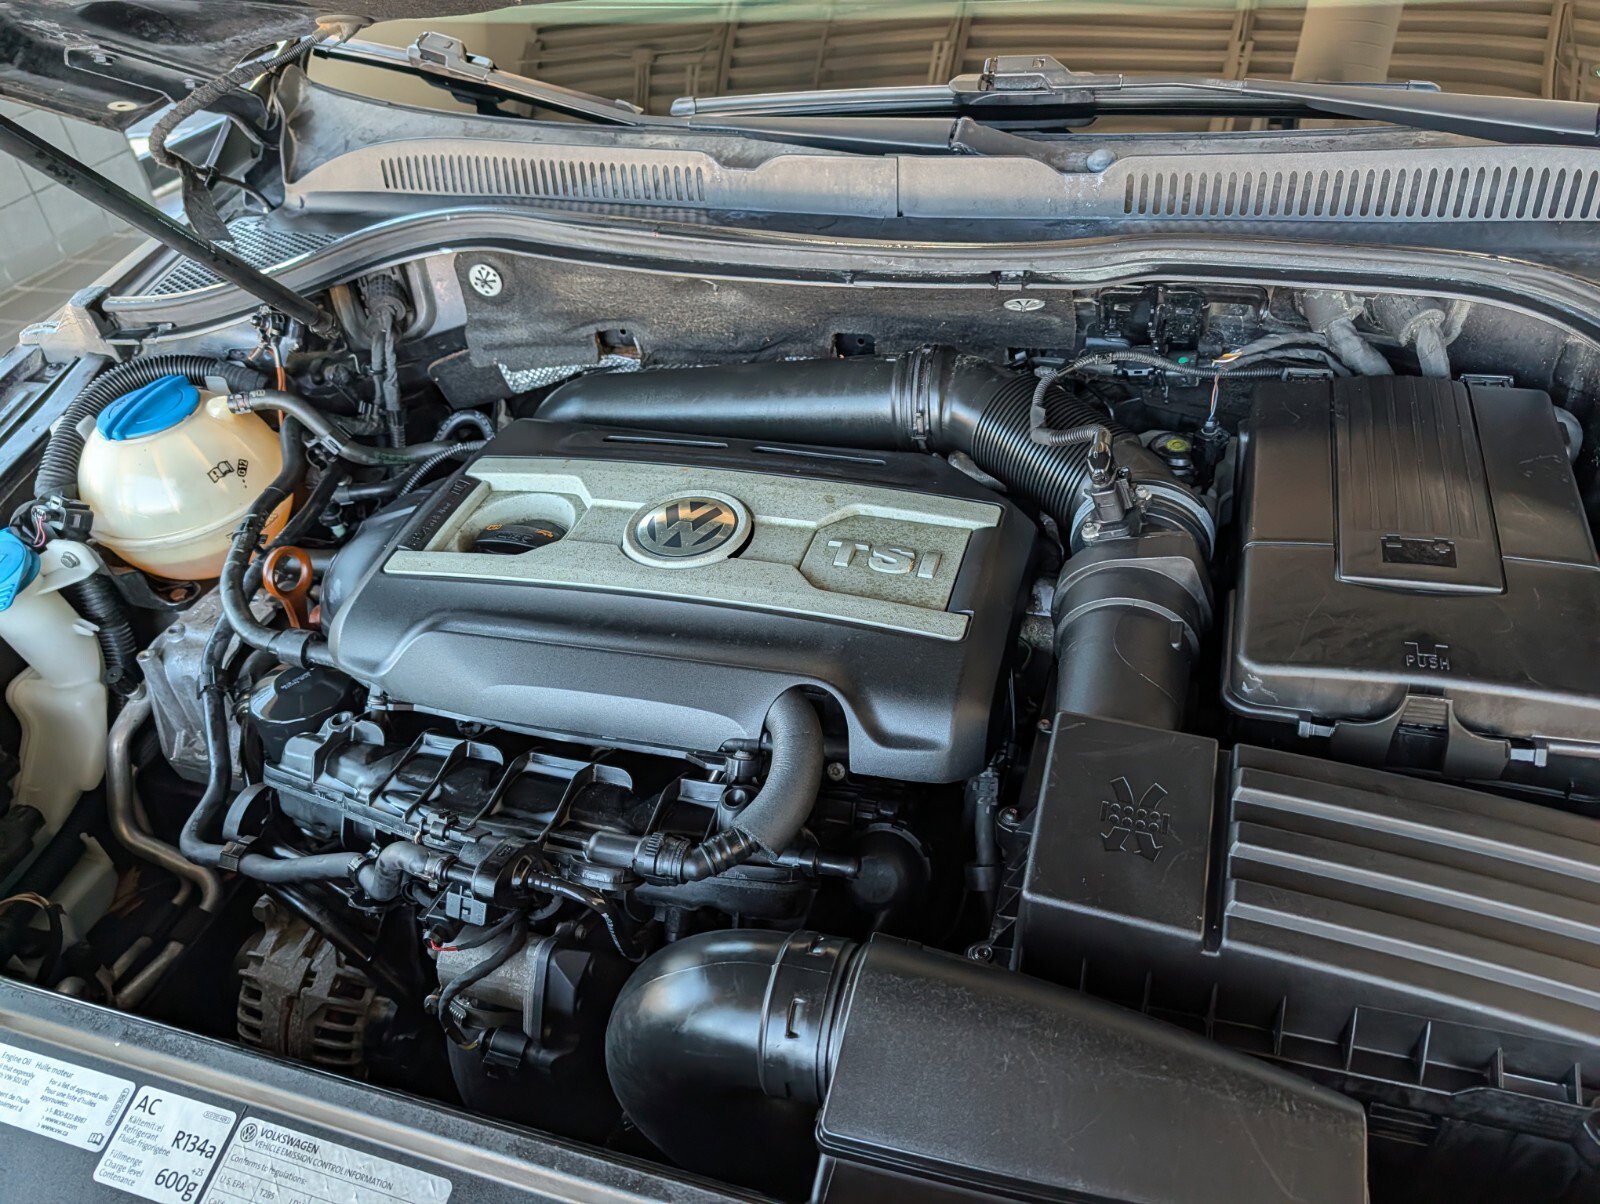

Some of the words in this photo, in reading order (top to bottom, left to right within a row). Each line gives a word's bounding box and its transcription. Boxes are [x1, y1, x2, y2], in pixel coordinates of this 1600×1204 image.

[827, 538, 942, 579] TSI
[1406, 654, 1450, 670] PUSH
[1, 1052, 22, 1063] Engine
[21, 1057, 32, 1066] Oil
[35, 1061, 52, 1072] Huile
[51, 1067, 74, 1078] moteur
[75, 1087, 99, 1098] approved
[134, 1095, 162, 1115] AC
[118, 1133, 137, 1146] Fluide
[123, 1124, 159, 1141] Refrigerant
[260, 1127, 320, 1155] VOLKSWAGEN
[171, 1130, 217, 1159] R134a
[104, 1159, 128, 1173] Charge
[128, 1165, 144, 1177] level
[230, 1153, 260, 1170] Conforms
[261, 1163, 268, 1171] to
[268, 1166, 307, 1185] regulations:
[254, 1139, 281, 1154] VEHICLE
[280, 1146, 313, 1164] EMISSION
[312, 1158, 344, 1174] CONTROL
[344, 1168, 394, 1190] INFORMATION
[99, 1169, 136, 1186] Contenance
[155, 1168, 198, 1202] 600g
